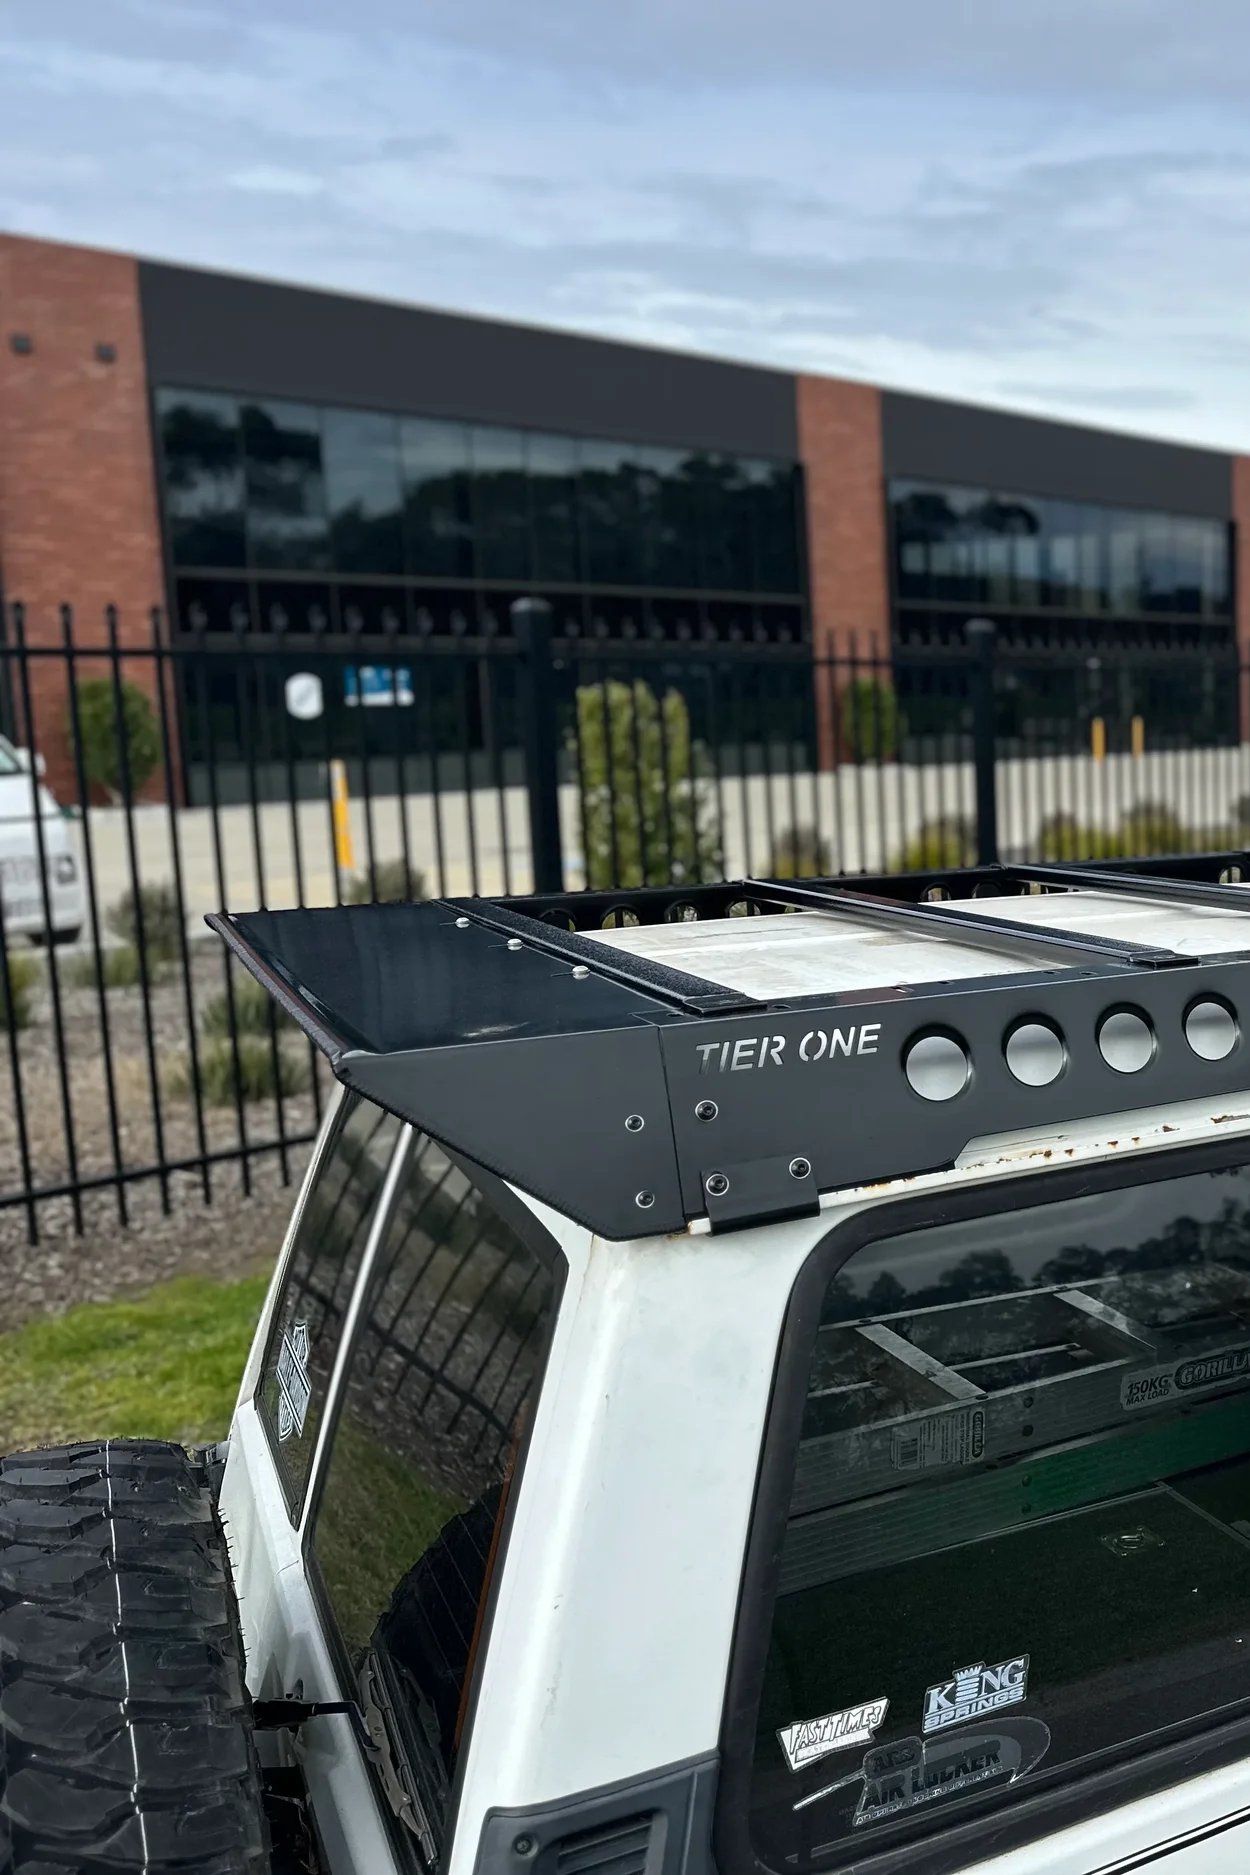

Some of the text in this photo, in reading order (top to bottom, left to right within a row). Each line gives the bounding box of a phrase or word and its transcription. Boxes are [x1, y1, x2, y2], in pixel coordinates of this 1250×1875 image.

[696, 1023, 882, 1074] TIER ONE
[1126, 1388, 1170, 1406] MAX LOAD
[1127, 1373, 1171, 1396] 150KG
[924, 1686, 1025, 1727] SPRINGS
